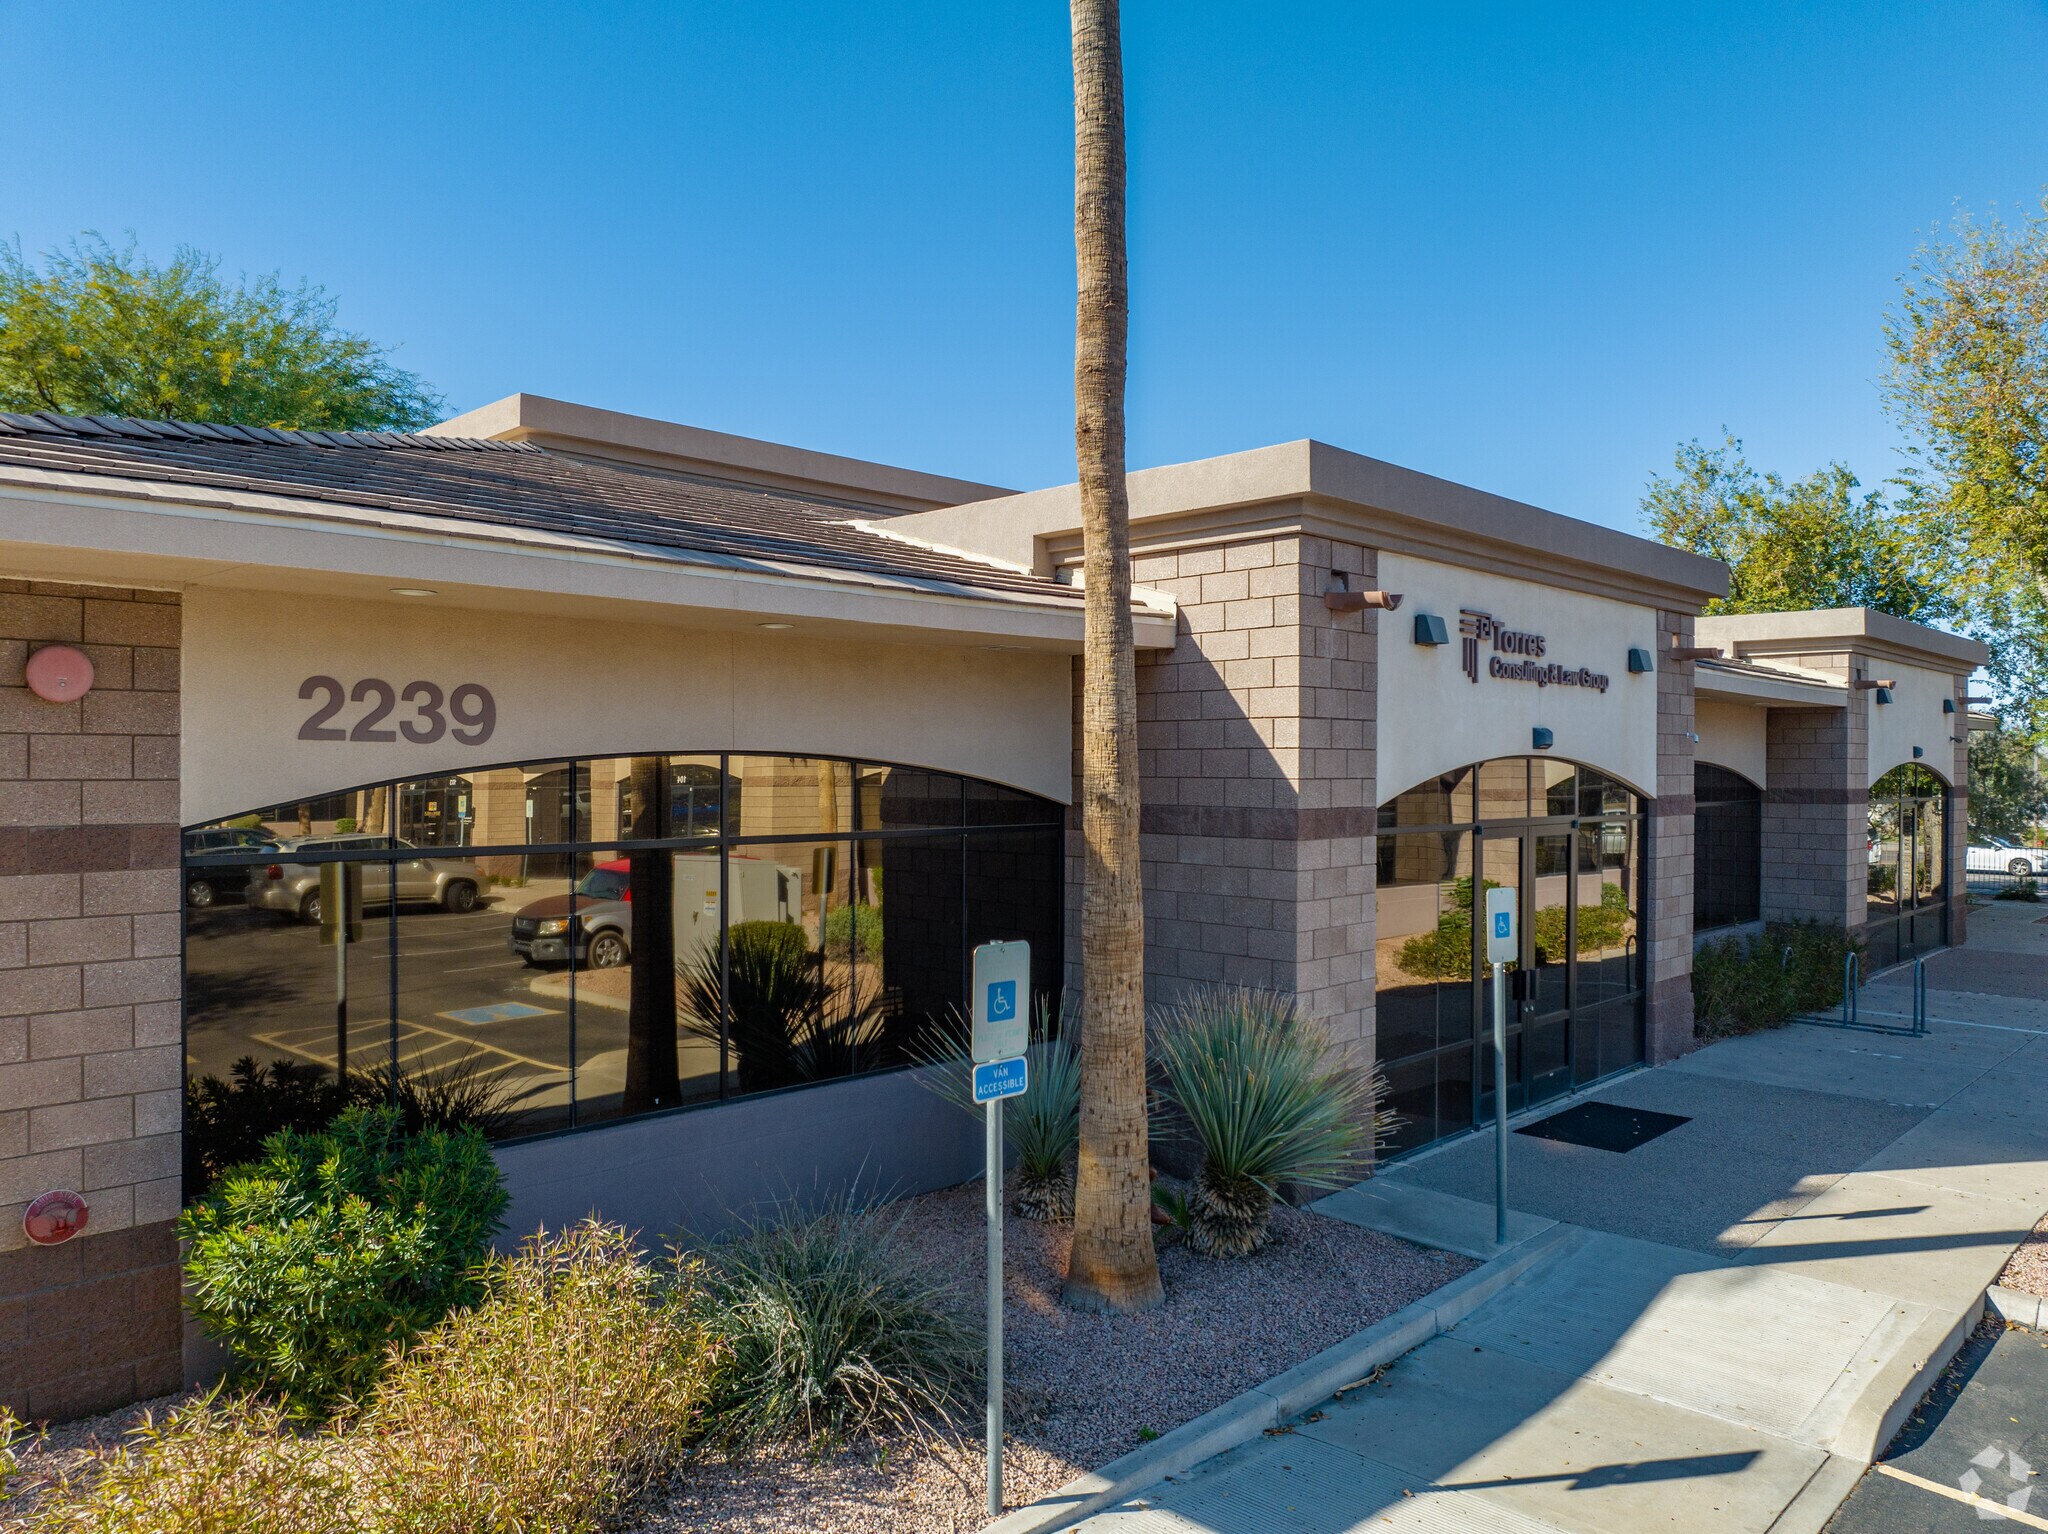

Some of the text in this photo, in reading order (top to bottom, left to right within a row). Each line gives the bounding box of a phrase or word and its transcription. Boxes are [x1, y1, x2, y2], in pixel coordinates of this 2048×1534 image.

[1492, 621, 1546, 657] Torres
[1489, 656, 1609, 694] Consulting & Law Group
[298, 675, 497, 746] 2239
[978, 1076, 1024, 1095] ACCESSIBLE
[993, 1064, 1009, 1079] VAN
